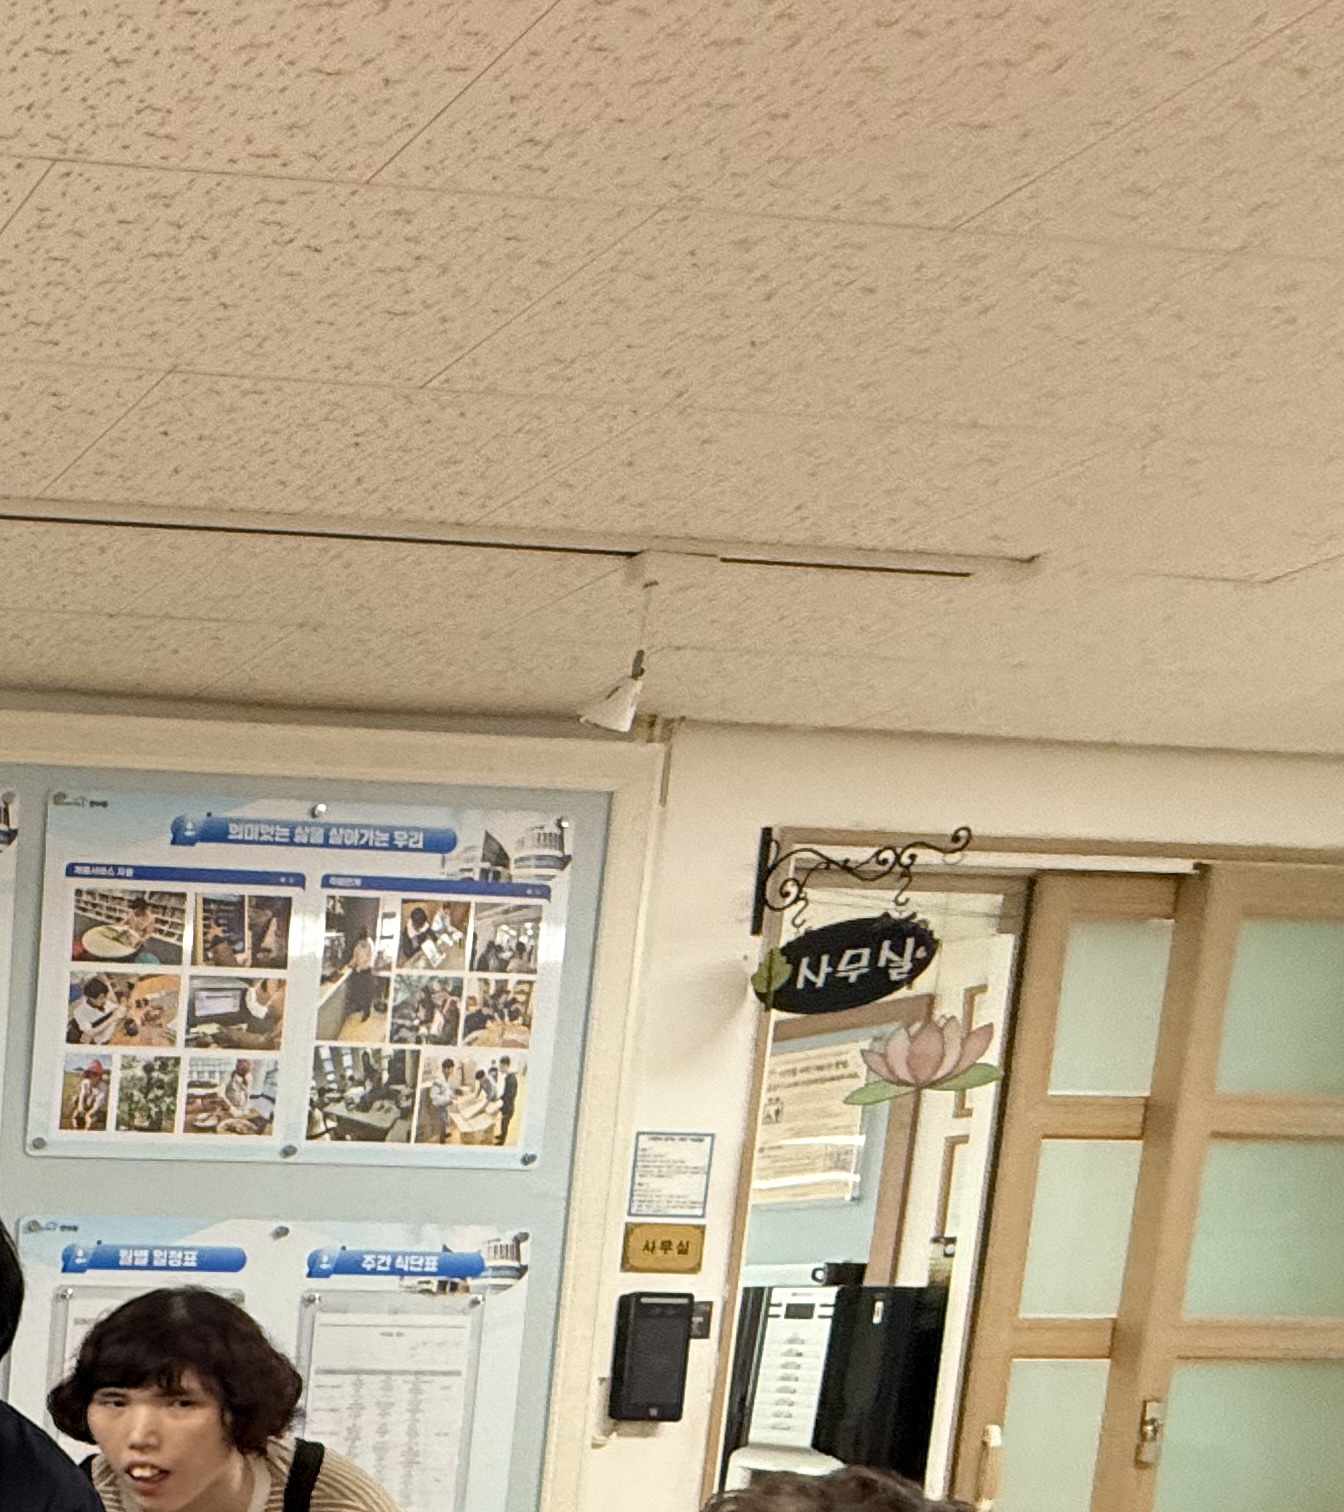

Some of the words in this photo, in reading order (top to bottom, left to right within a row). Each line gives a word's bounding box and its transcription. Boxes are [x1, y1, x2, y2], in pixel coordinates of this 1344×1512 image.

[294, 824, 324, 843] 삶을
[328, 827, 390, 846] 살아가는
[393, 830, 424, 849] 우리
[795, 937, 920, 991] 사무실
[642, 1240, 690, 1255] 사무실
[118, 1249, 149, 1266] 월별
[153, 1249, 198, 1268] 일정표
[361, 1254, 391, 1271] 주간
[395, 1255, 438, 1273] 식단표
